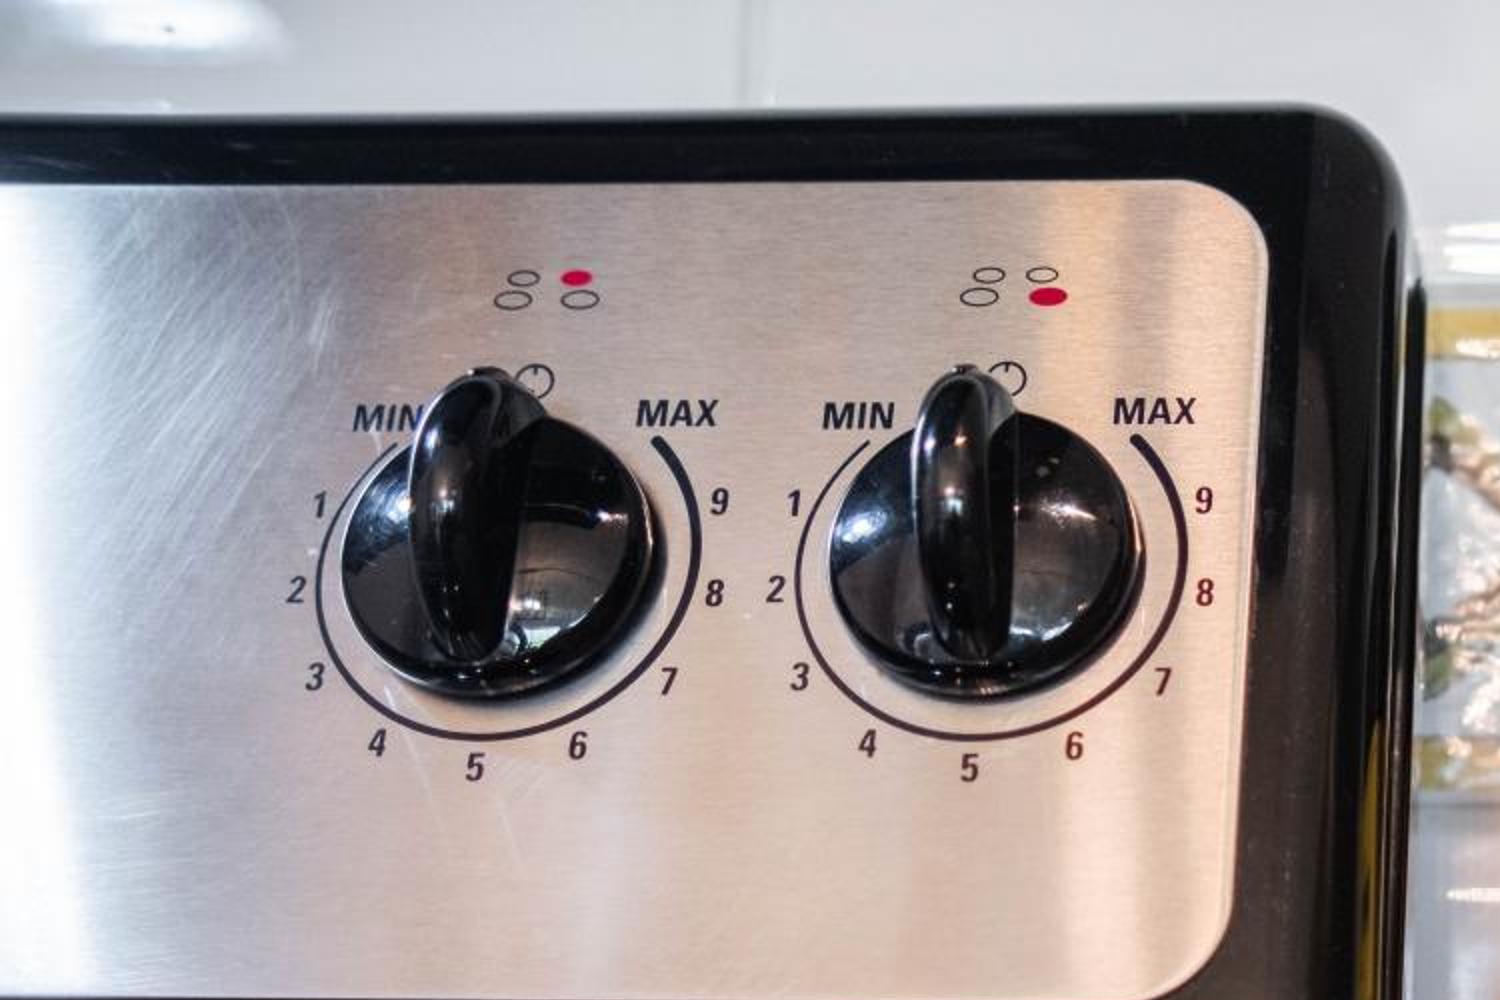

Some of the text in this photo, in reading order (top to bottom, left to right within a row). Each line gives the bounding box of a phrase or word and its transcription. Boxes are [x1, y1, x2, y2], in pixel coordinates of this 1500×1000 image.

[353, 404, 424, 432] MIN
[635, 399, 719, 428] MAX
[822, 401, 895, 430] MIN
[1112, 397, 1196, 425] MAX
[314, 491, 328, 519] 1
[710, 487, 730, 516] 9
[787, 489, 801, 518] 1
[1194, 486, 1214, 515] 9
[286, 575, 308, 605] 2
[704, 580, 725, 608] 8
[765, 574, 787, 604] 2
[1195, 578, 1215, 607] 8
[305, 663, 325, 692] 3
[660, 666, 679, 696] 7
[790, 663, 811, 692] 3
[1154, 667, 1173, 697] 7
[367, 729, 388, 758] 4
[568, 731, 588, 761] 6
[857, 729, 878, 759] 4
[1064, 731, 1084, 761] 6
[465, 752, 486, 782] 5
[960, 753, 980, 783] 5
